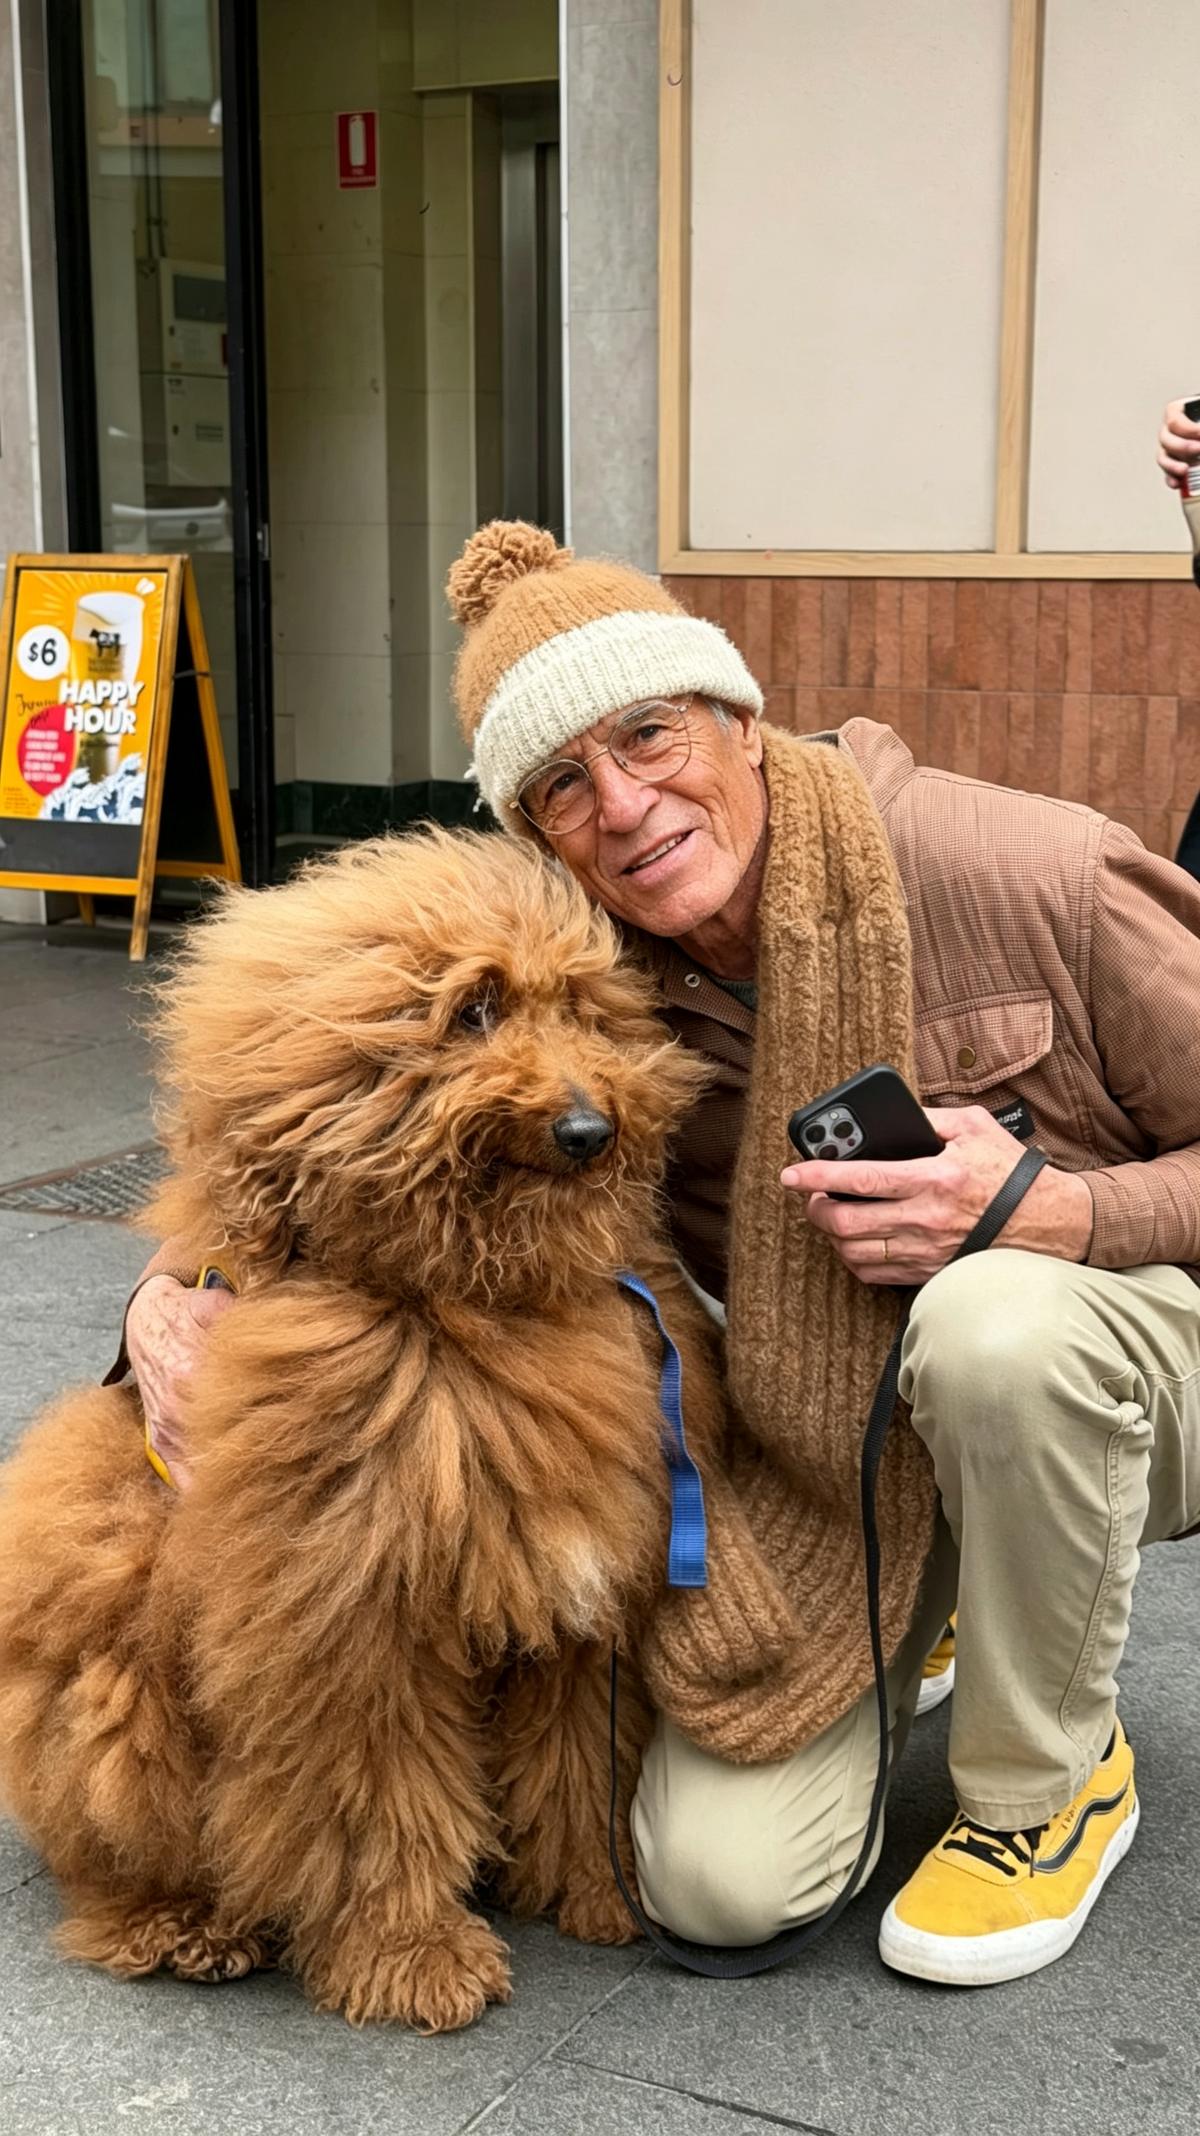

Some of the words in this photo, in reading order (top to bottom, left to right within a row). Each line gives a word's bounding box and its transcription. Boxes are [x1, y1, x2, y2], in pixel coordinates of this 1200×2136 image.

[28, 637, 57, 666] $6
[59, 679, 145, 707] HAPPY
[64, 704, 137, 735] HOUR
